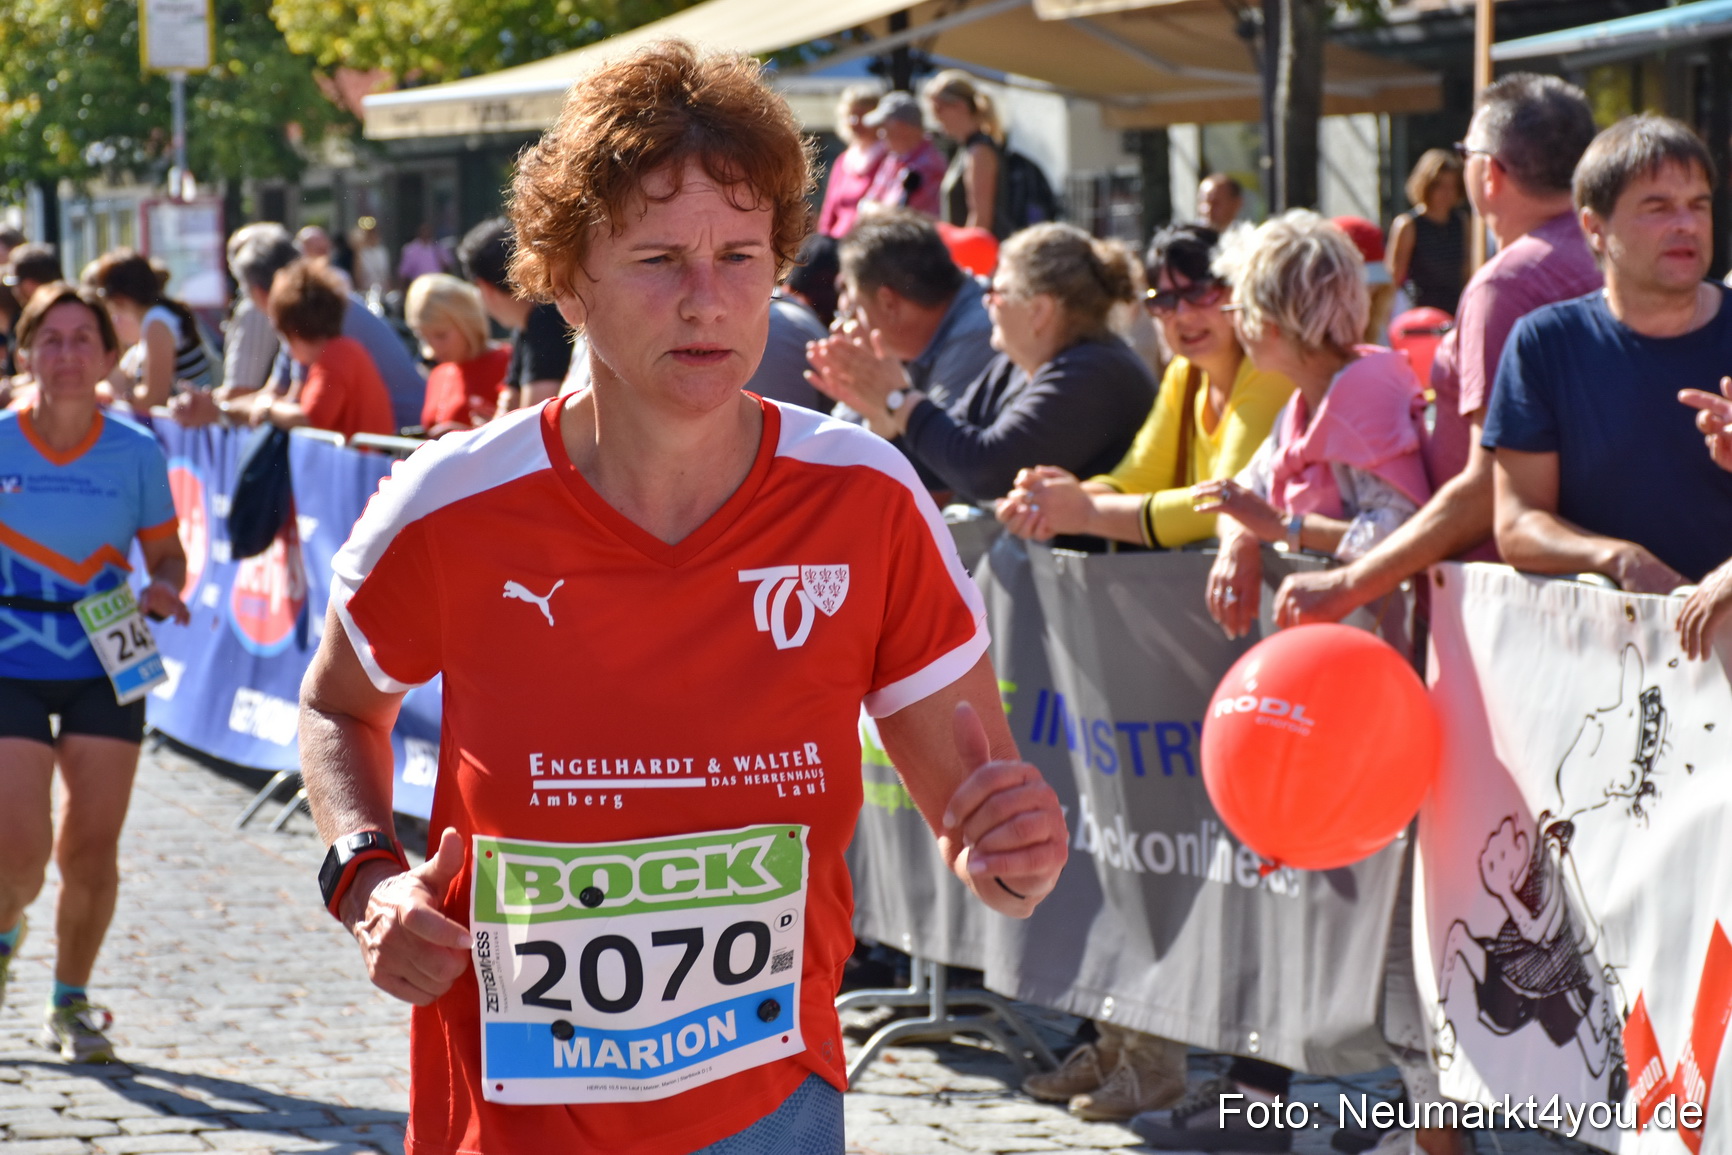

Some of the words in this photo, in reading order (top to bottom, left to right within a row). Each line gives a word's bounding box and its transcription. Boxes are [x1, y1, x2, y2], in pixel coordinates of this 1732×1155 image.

[529, 752, 694, 776] ENGELHARDT
[707, 758, 722, 774] &
[732, 741, 822, 772] WALTER
[711, 775, 737, 788] DAS
[744, 767, 825, 786] HERRENHAUS
[777, 778, 827, 798] Lauf
[529, 792, 624, 810] Amberg
[501, 840, 779, 910] BOCK
[780, 913, 793, 928] D
[514, 920, 771, 1014] 2070
[552, 1010, 737, 1071] MARION
